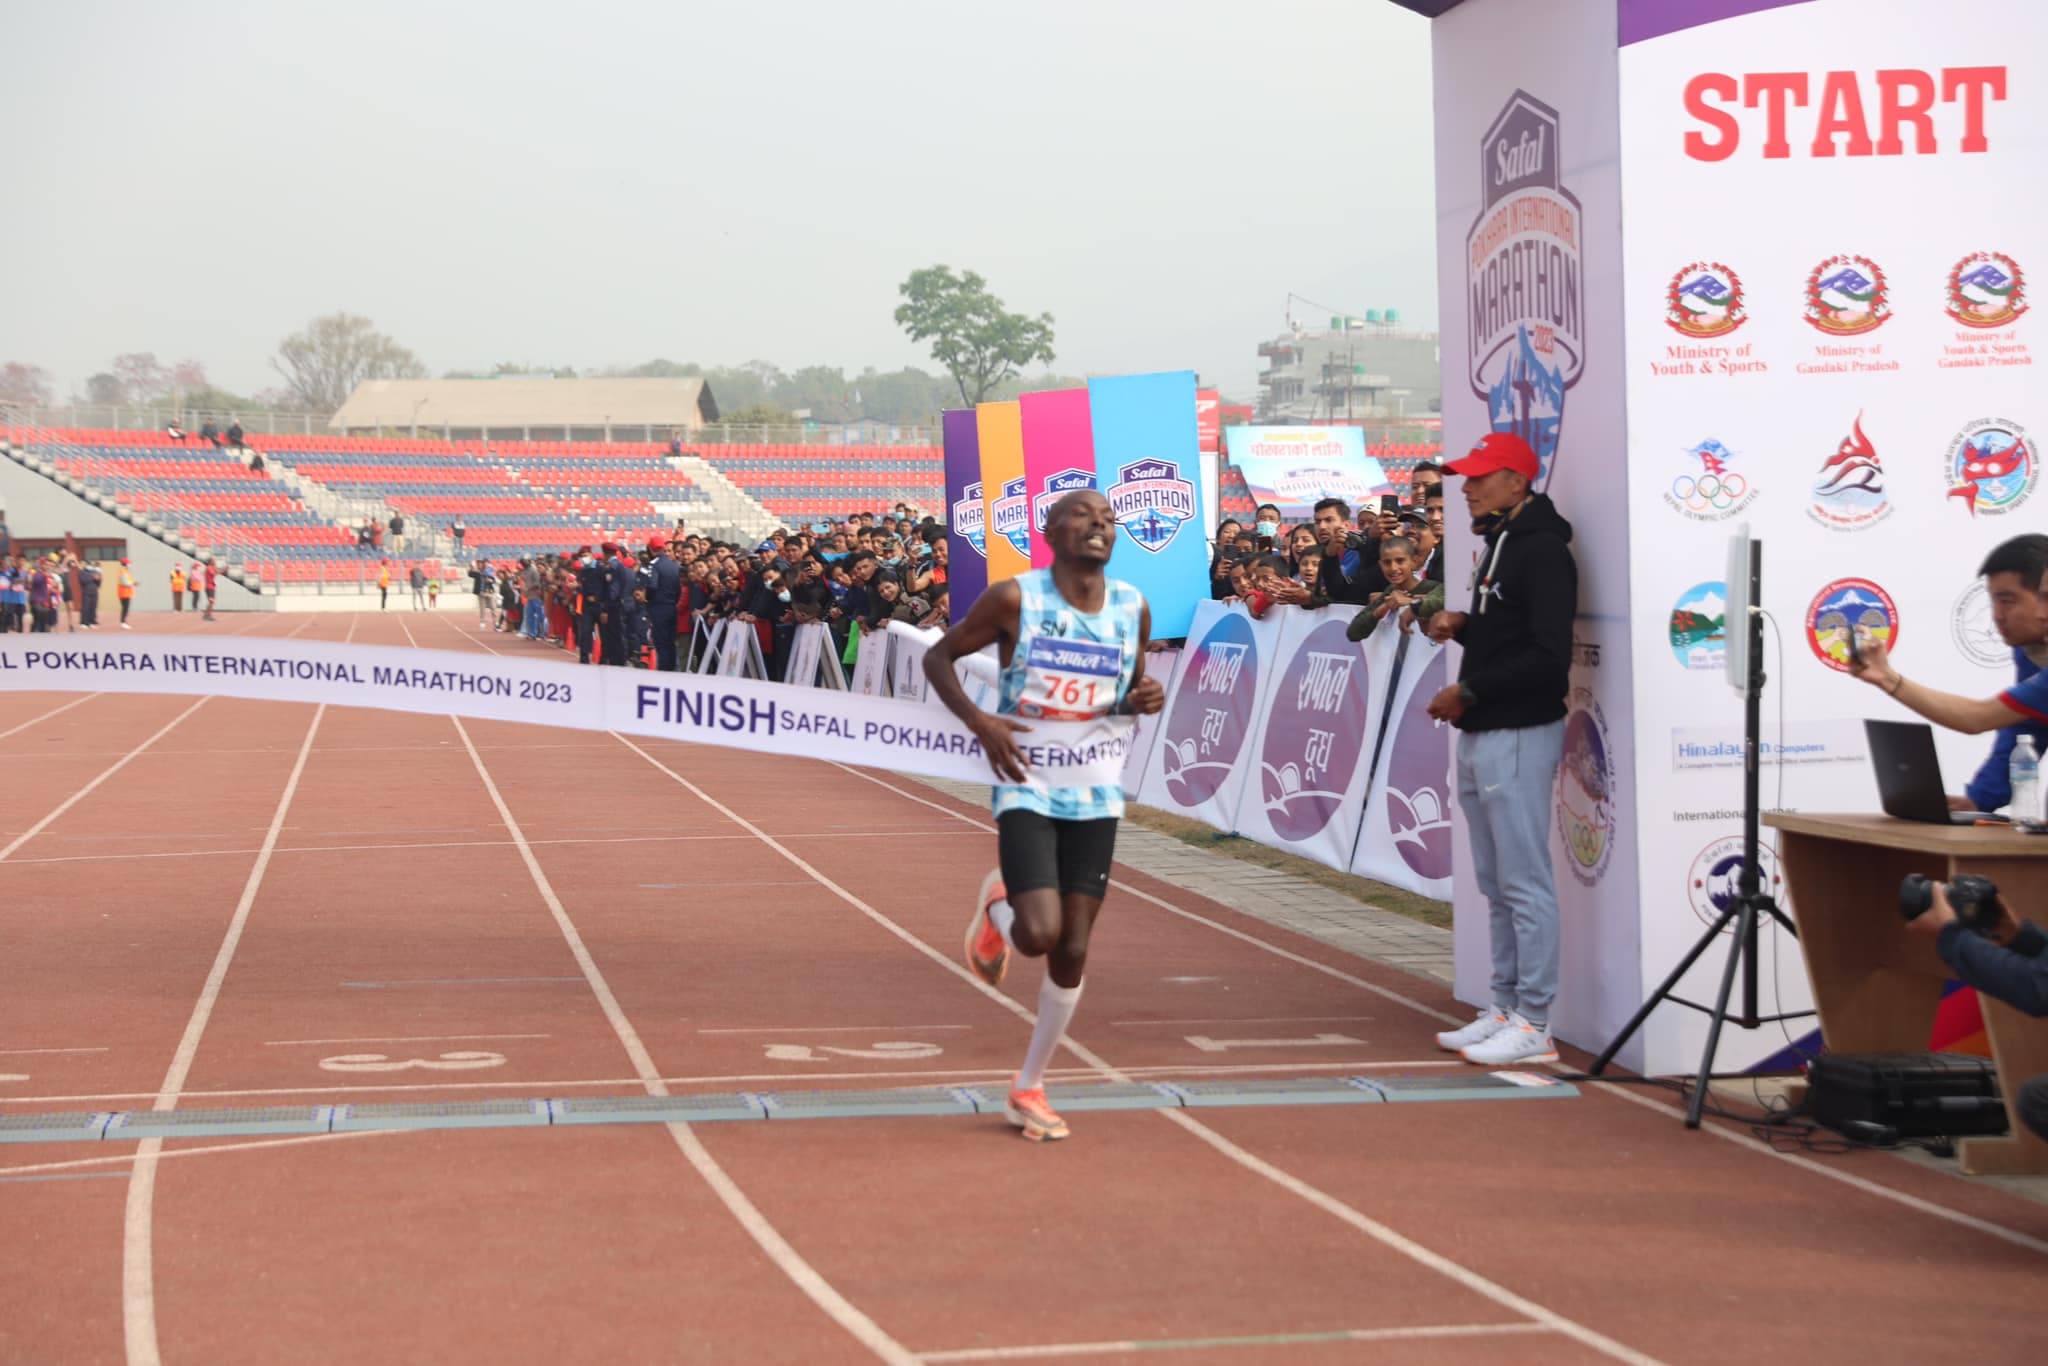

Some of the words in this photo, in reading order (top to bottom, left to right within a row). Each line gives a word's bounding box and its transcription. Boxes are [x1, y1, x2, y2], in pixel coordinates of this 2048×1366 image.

[1683, 66, 2007, 162] START
[1495, 124, 1545, 186] Safal
[1473, 240, 1578, 357] MARATHON
[1944, 344, 1975, 355] Youth
[1992, 343, 2027, 355] Sports
[1955, 332, 2000, 343] Ministry
[1666, 345, 1730, 361] Ministry
[1736, 344, 1752, 356] of
[1815, 346, 1866, 360] Ministry
[1869, 344, 1882, 356] of
[1938, 357, 1985, 368] Gandaki
[1988, 355, 2032, 366] Pradesh
[1650, 359, 1693, 376] Youth
[1699, 360, 1712, 373] &
[1718, 358, 1768, 376] Sports
[1796, 361, 1848, 374] Gandaki
[1852, 359, 1900, 372] Pradesh
[1056, 476, 1089, 489] Safal
[1130, 466, 1167, 479] Safal
[1112, 489, 1190, 513] MARATHON
[0, 653, 18, 669] L
[24, 650, 156, 672] POKHARA
[163, 654, 365, 685] INTERNATIONAL
[373, 666, 512, 697] MARATHON
[519, 680, 573, 704] 2023
[1197, 641, 1249, 695] सफल
[1043, 674, 1098, 707] 761
[1297, 651, 1356, 714] सफल
[636, 684, 776, 736] FINISH
[780, 709, 857, 741] SAFAL
[864, 721, 981, 758] POKHARA
[1201, 708, 1228, 756] दूध
[1304, 728, 1335, 783] दूध
[1679, 742, 1770, 760] Himalayn
[1773, 743, 1825, 755] Computers
[1673, 810, 1745, 823] Internationa
[1184, 1033, 1368, 1051] 1
[319, 1050, 508, 1073] 3
